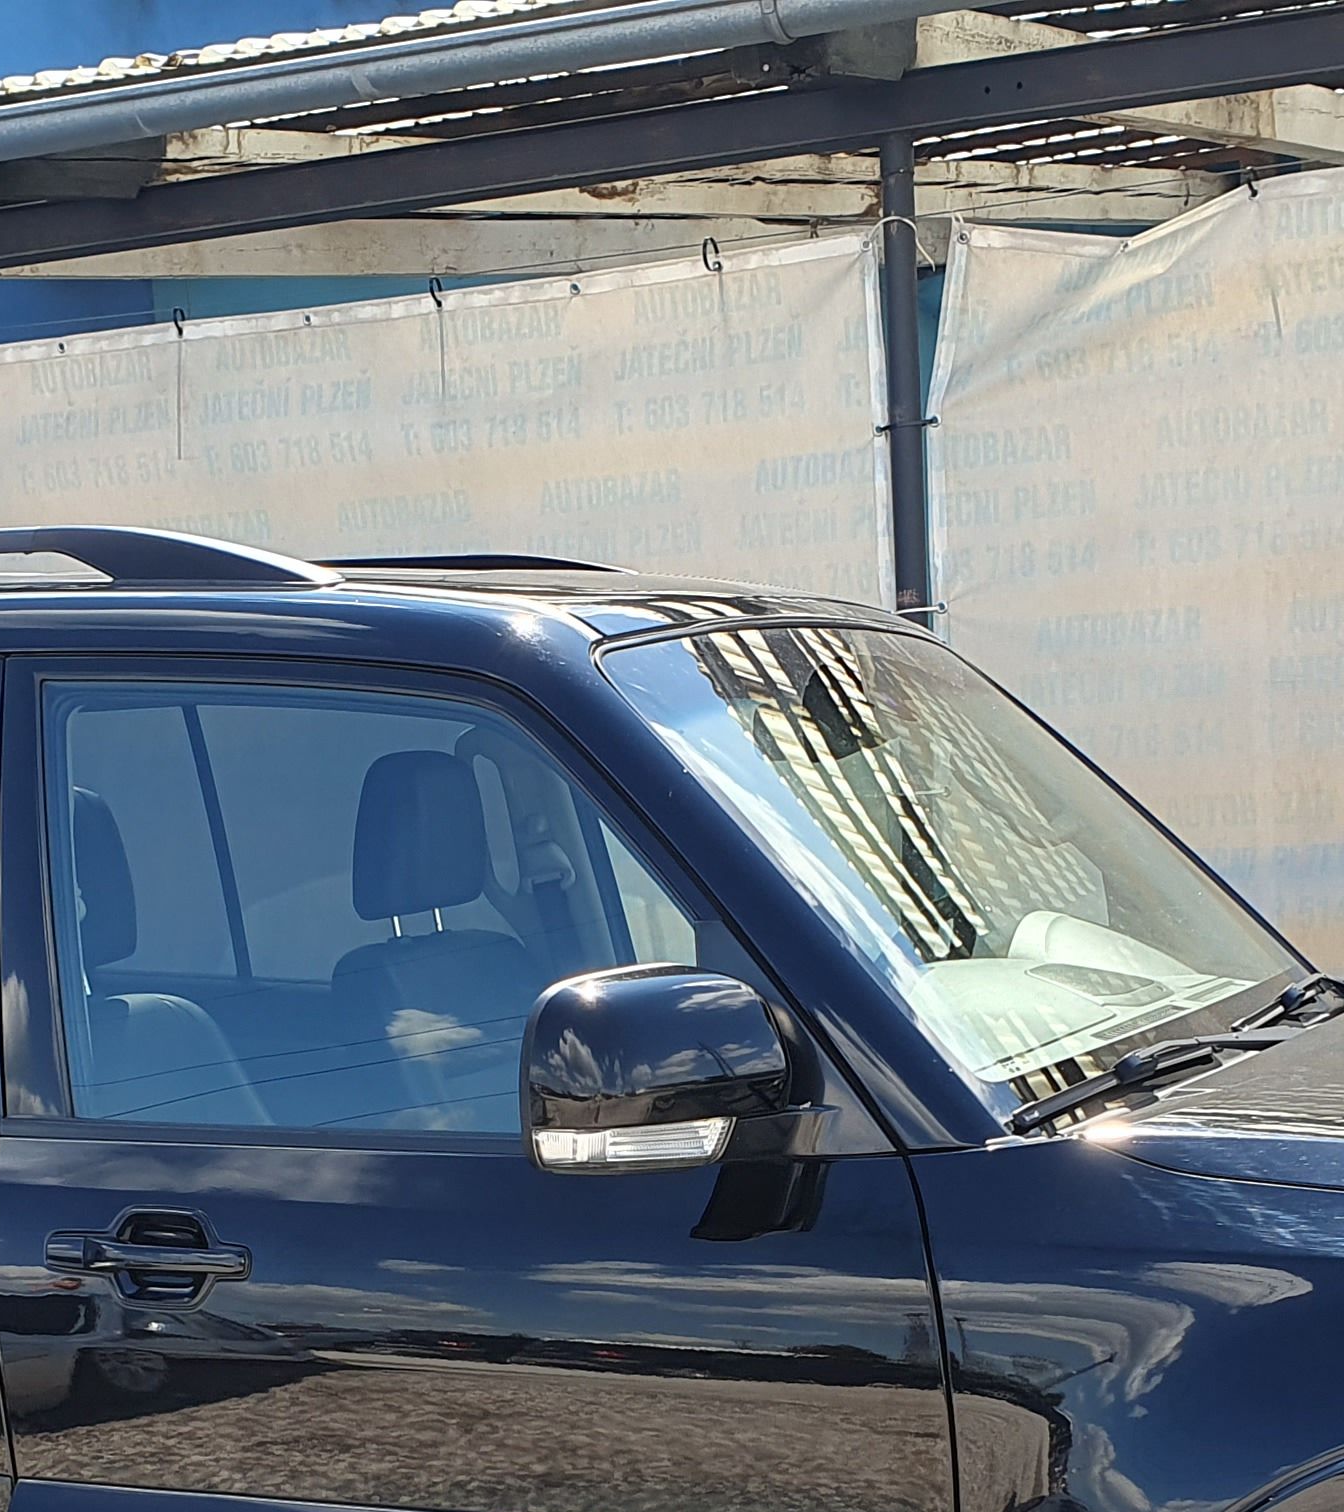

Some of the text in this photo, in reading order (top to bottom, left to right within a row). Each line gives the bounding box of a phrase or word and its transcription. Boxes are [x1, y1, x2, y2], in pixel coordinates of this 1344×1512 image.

[633, 270, 783, 325] AUTOBAZAR
[215, 328, 353, 372] AUTOBAZAR
[419, 302, 561, 353] AUTOBAZAR
